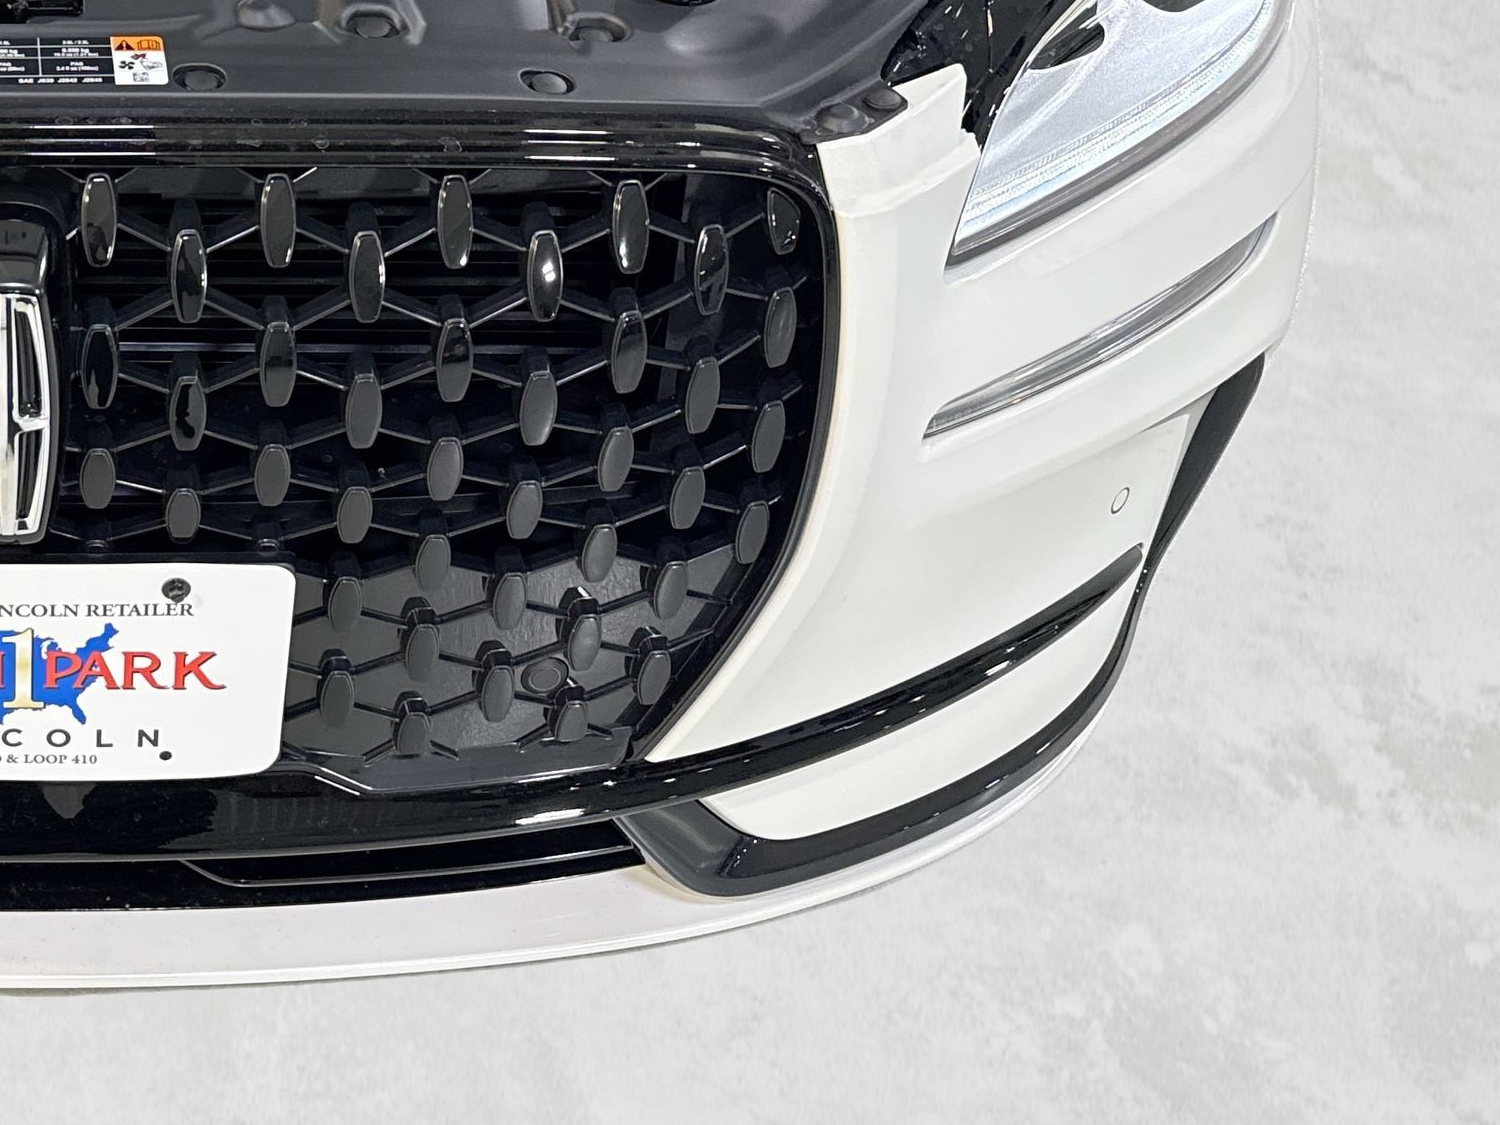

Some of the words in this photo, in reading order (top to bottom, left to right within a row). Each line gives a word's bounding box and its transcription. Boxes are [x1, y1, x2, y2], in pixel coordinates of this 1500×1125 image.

[85, 602, 194, 618] RETAILER
[43, 650, 228, 691] PARK
[6, 754, 20, 764] &
[23, 754, 68, 764] LOOP
[71, 754, 98, 764] 410
